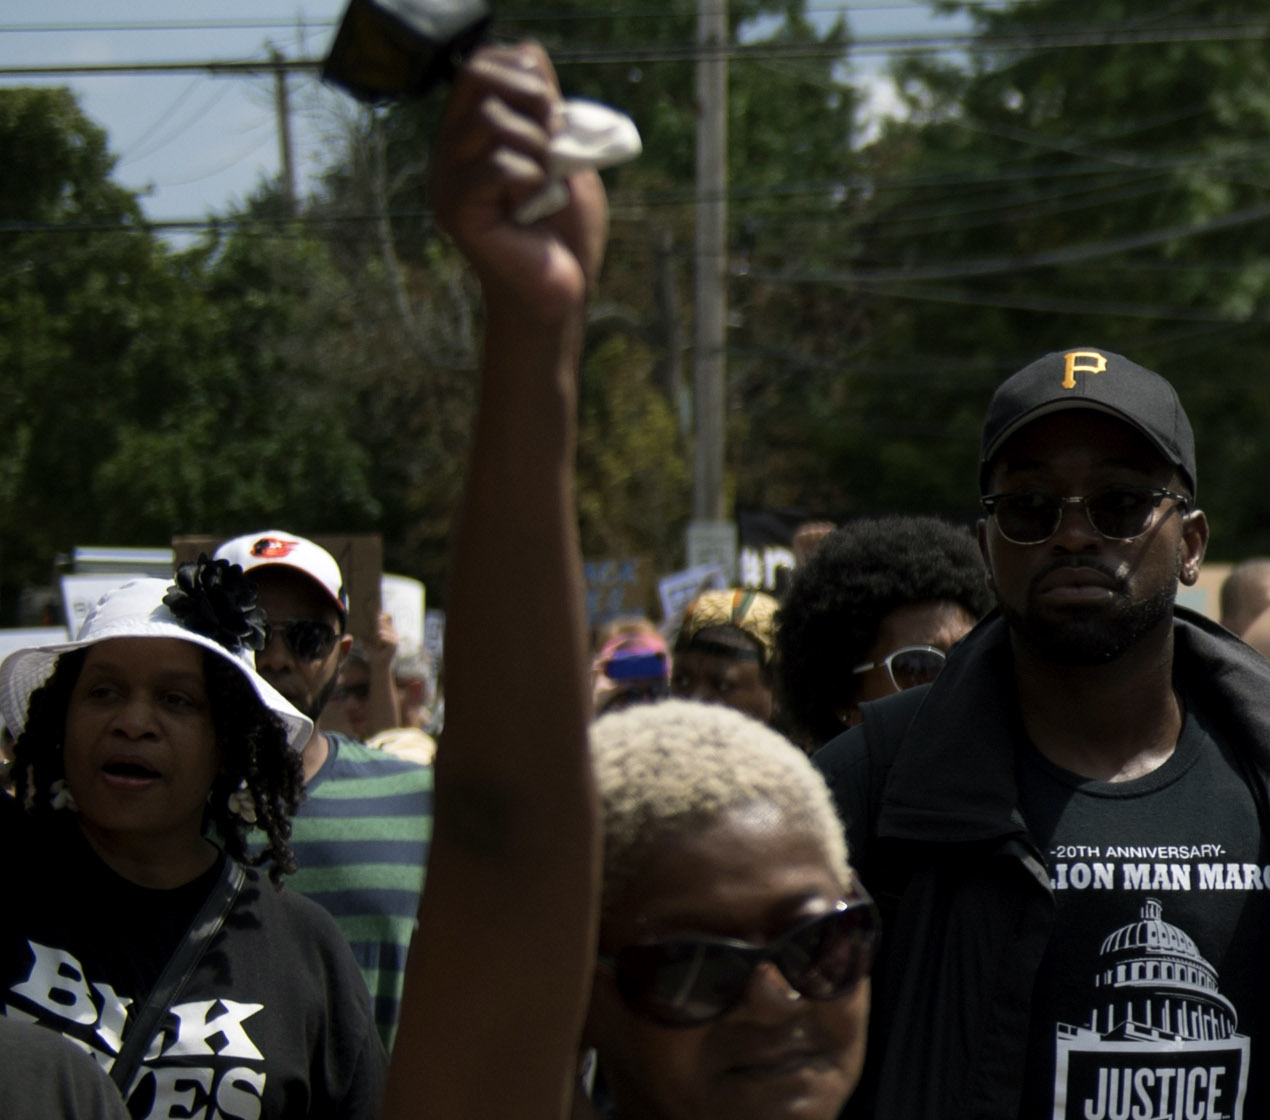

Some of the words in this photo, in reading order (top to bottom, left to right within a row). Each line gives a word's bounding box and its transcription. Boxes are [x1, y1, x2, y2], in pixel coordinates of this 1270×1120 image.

[1061, 351, 1107, 389] P
[1050, 862, 1116, 891] ION
[1123, 862, 1192, 891] MAN
